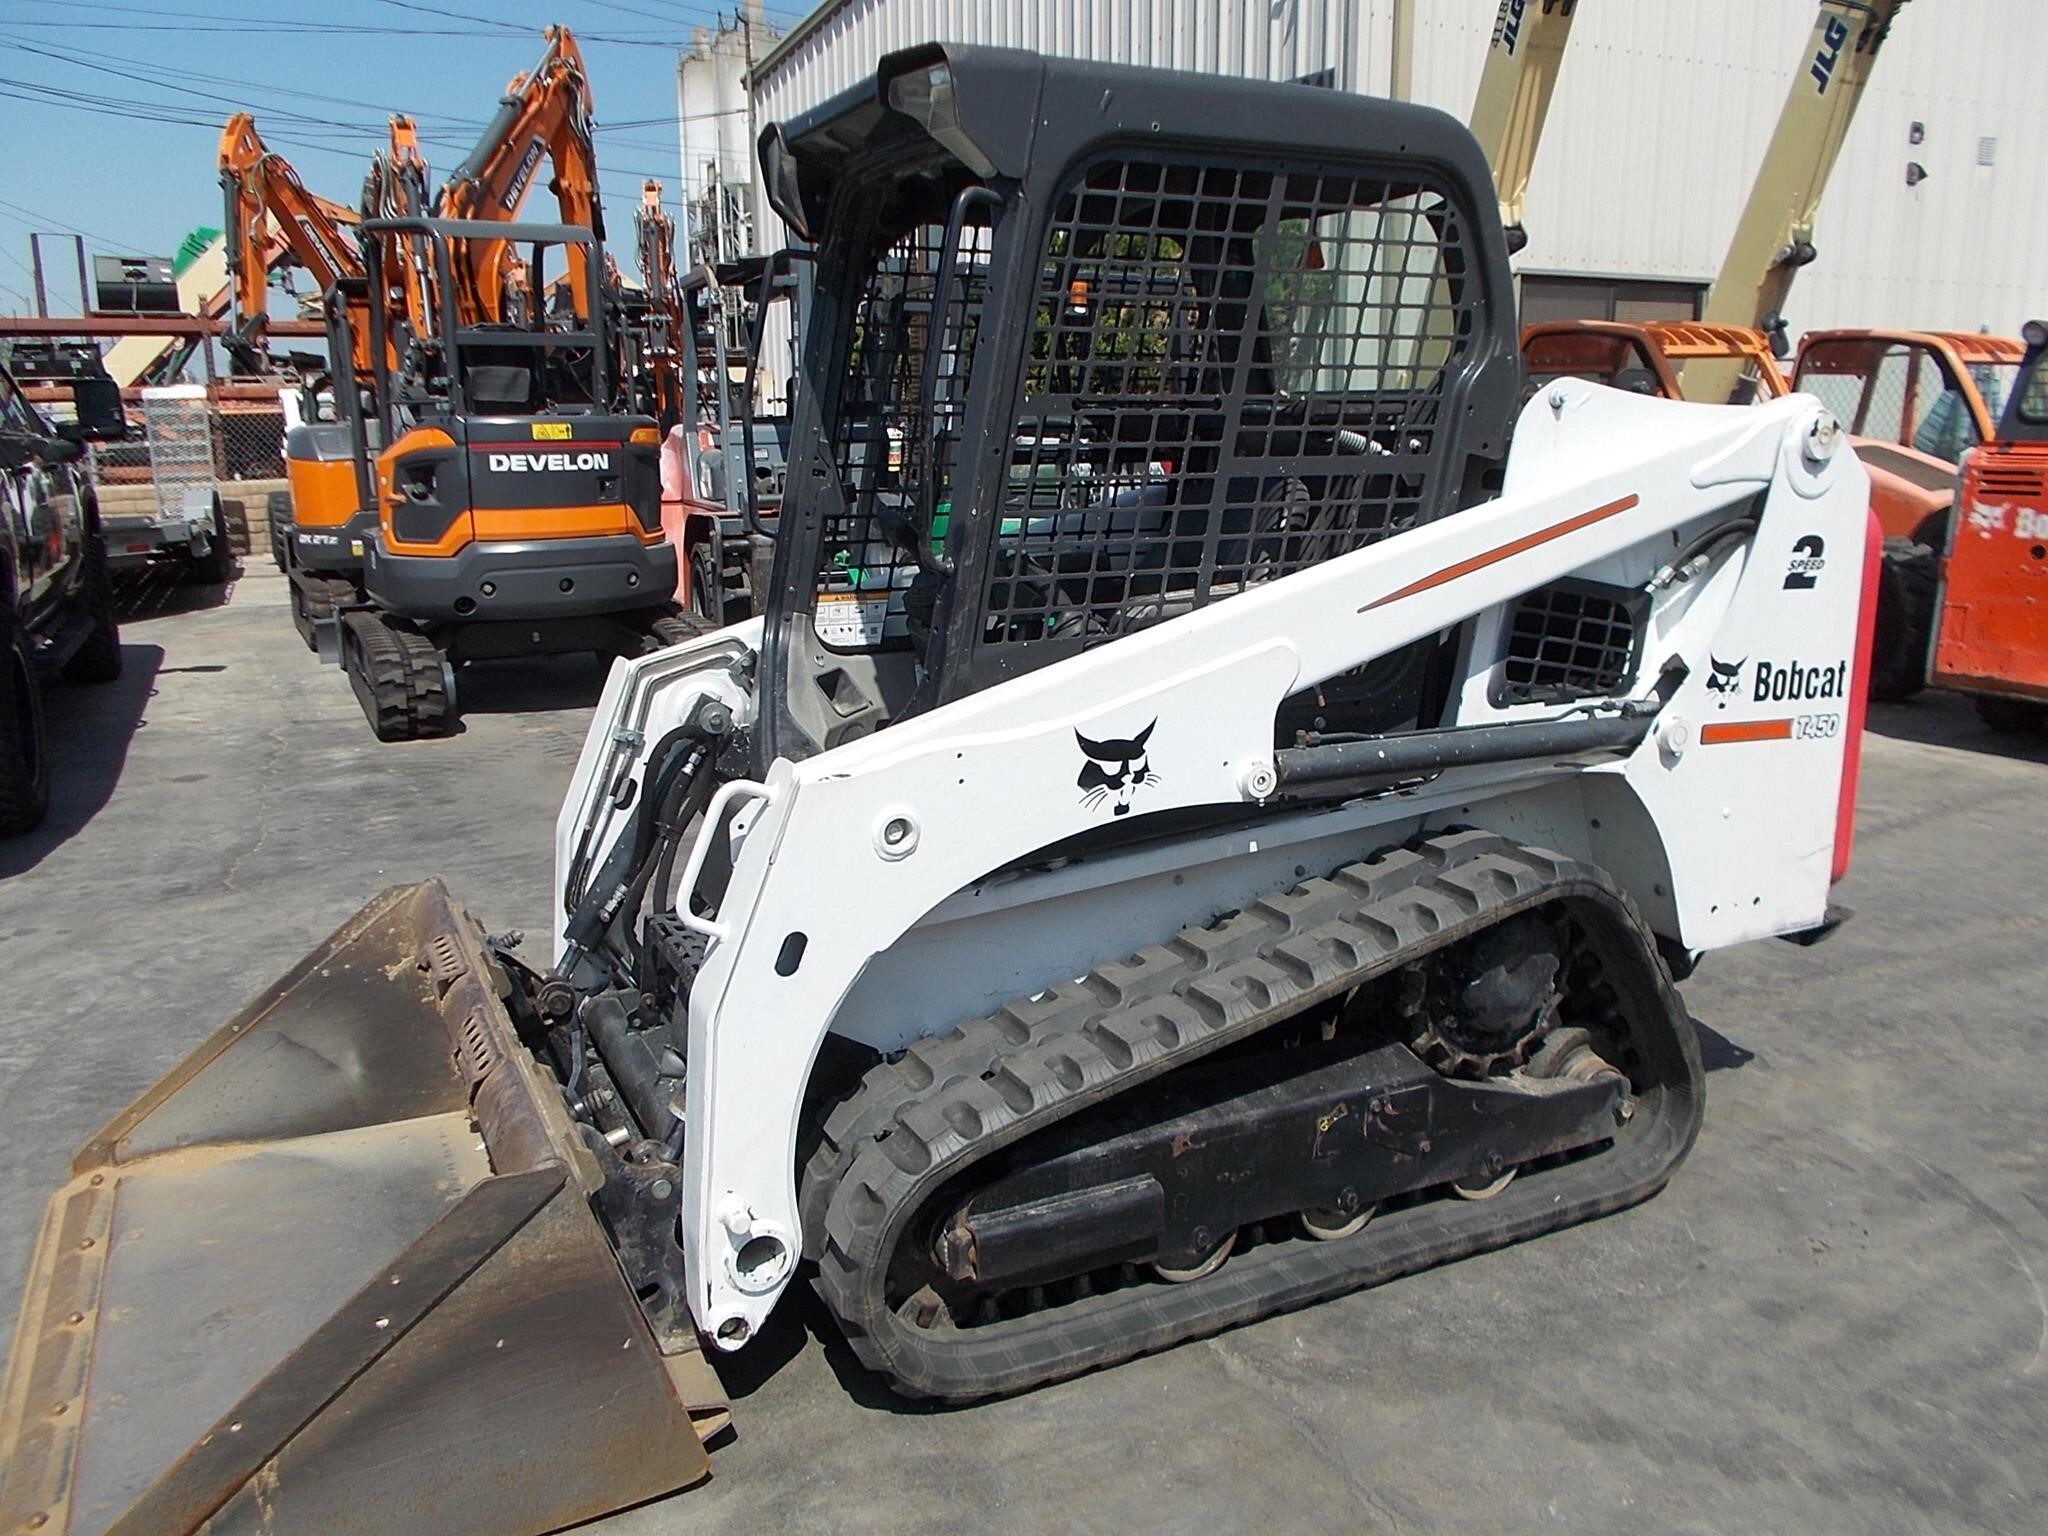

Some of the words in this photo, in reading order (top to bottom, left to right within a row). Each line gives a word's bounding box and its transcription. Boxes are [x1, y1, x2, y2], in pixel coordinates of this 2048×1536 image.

[1810, 15, 1848, 95] JLG
[505, 143, 540, 210] DEVELON
[489, 453, 610, 472] DEVELON
[1782, 534, 1825, 590] 2
[1787, 559, 1826, 571] SPEED
[1753, 660, 1846, 702] Bobcat
[1796, 713, 1842, 740] T450
